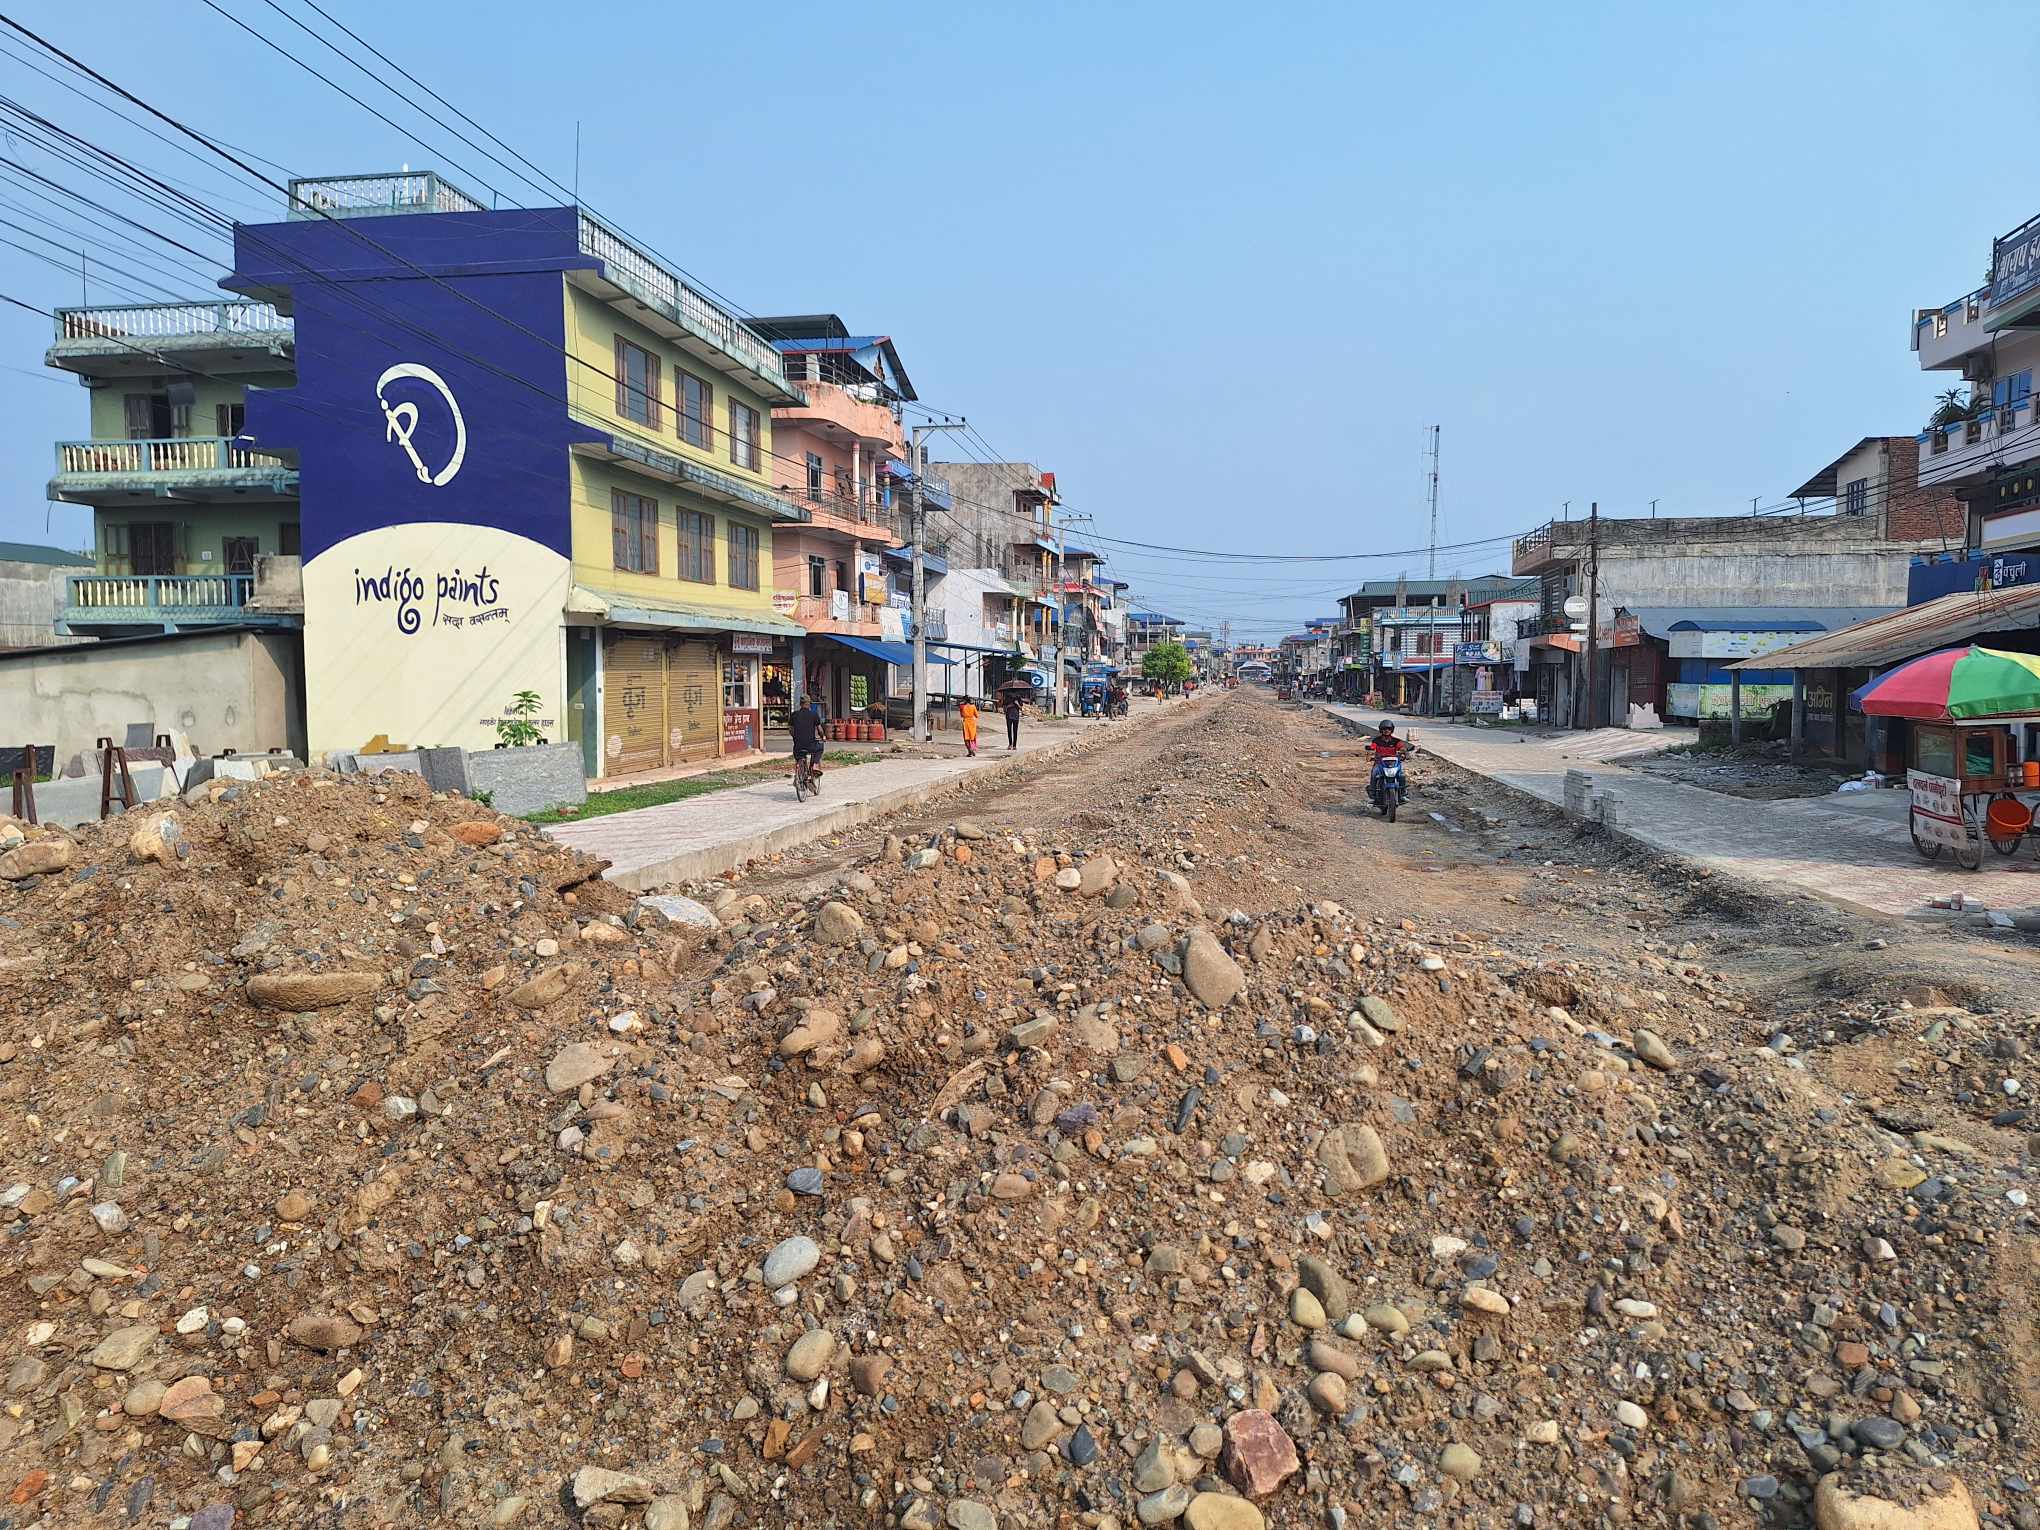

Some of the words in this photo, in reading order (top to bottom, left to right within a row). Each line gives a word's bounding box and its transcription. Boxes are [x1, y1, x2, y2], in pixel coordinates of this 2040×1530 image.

[355, 566, 424, 635] indigo
[433, 566, 499, 627] paints
[442, 613, 464, 630] सदा
